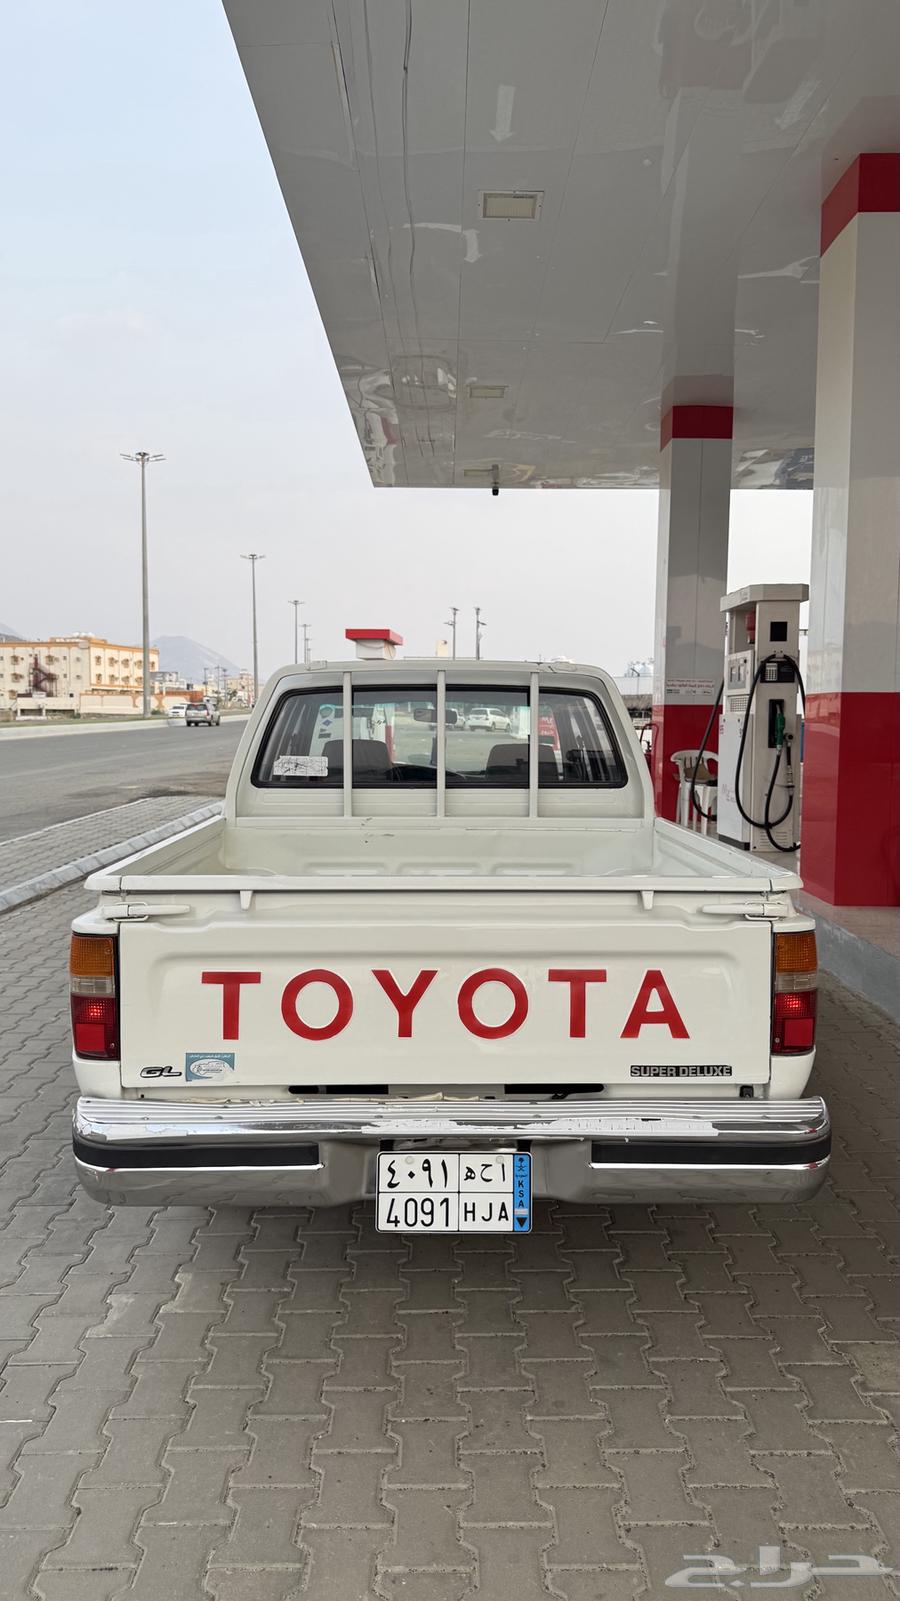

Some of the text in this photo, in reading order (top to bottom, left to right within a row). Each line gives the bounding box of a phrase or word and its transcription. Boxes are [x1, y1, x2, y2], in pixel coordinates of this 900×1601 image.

[201, 967, 690, 1040] TOYOTA
[140, 1066, 182, 1079] GL
[630, 1065, 732, 1077] SUPER DELUXE
[517, 1180, 525, 1208] KSA
[386, 1197, 450, 1227] 4091
[463, 1201, 509, 1222] HJA
